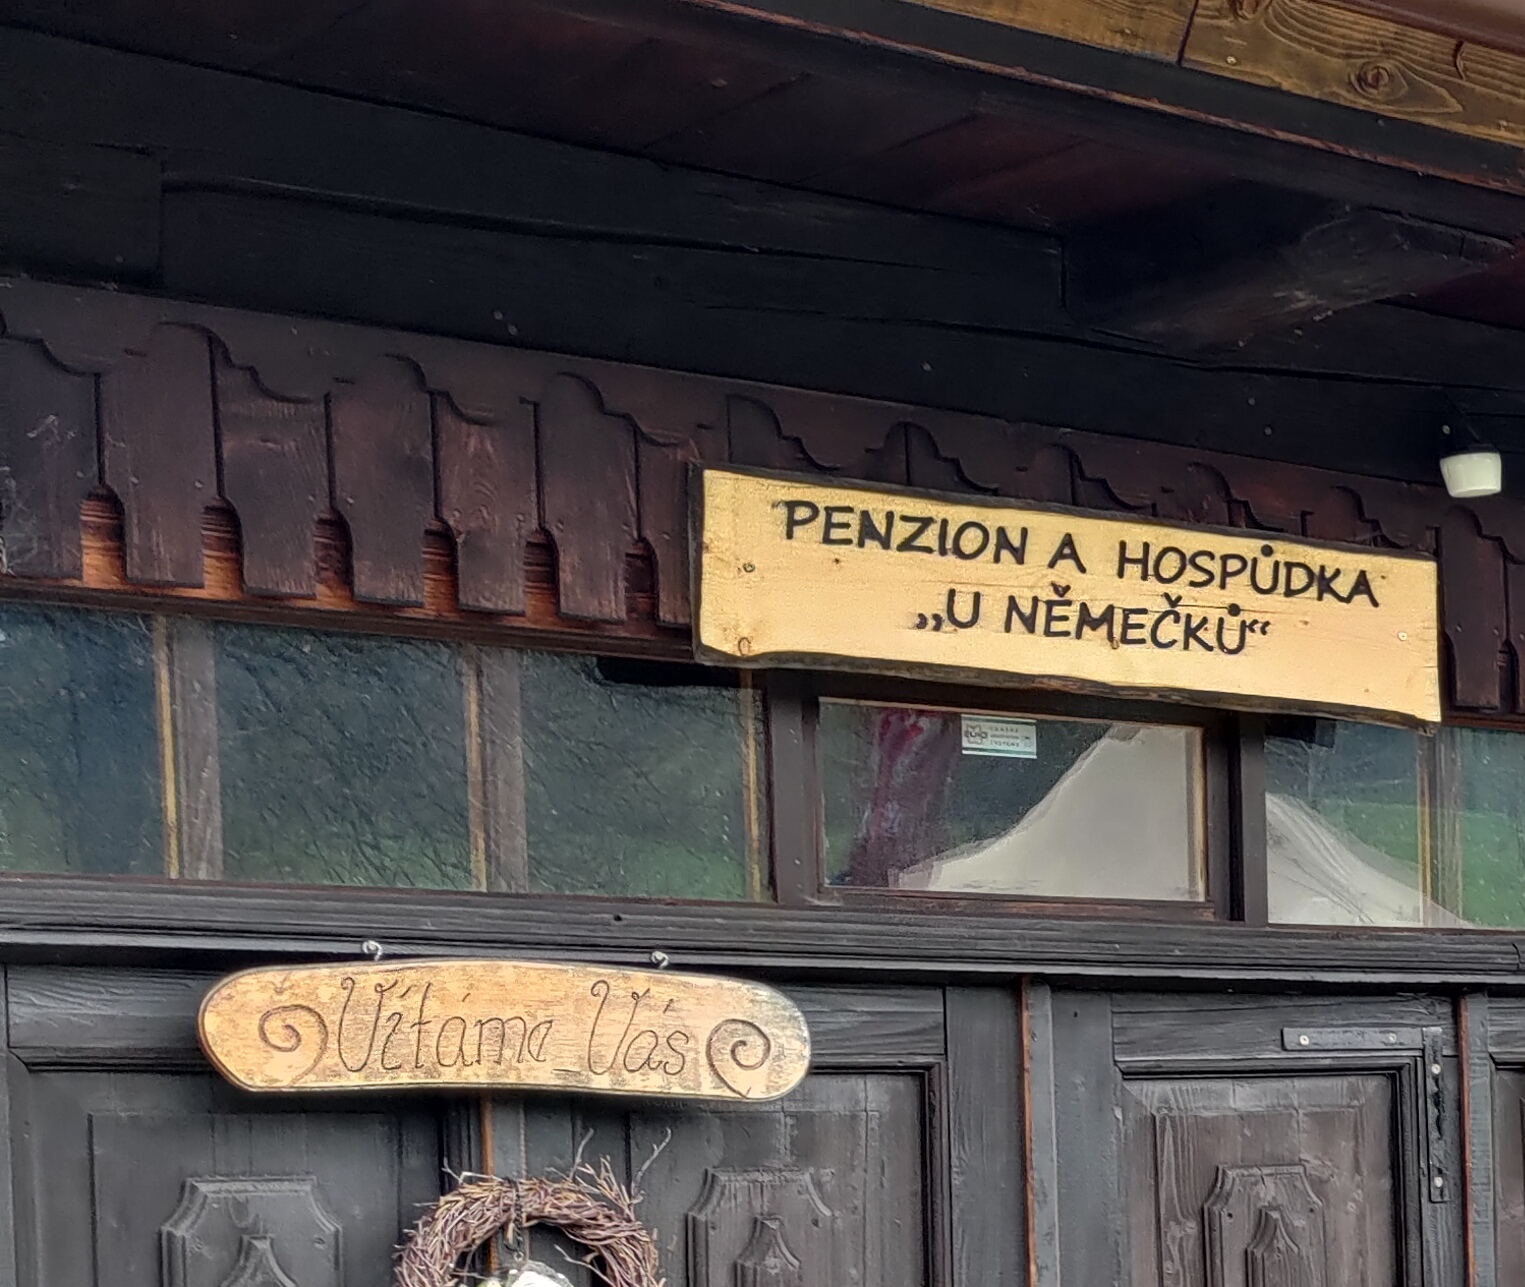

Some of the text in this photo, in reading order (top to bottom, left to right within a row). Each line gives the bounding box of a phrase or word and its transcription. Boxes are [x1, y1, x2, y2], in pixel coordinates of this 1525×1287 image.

[783, 500, 1380, 608] PENZION A HOSPŮDKA
[337, 976, 690, 1076] Vítáme Vás
